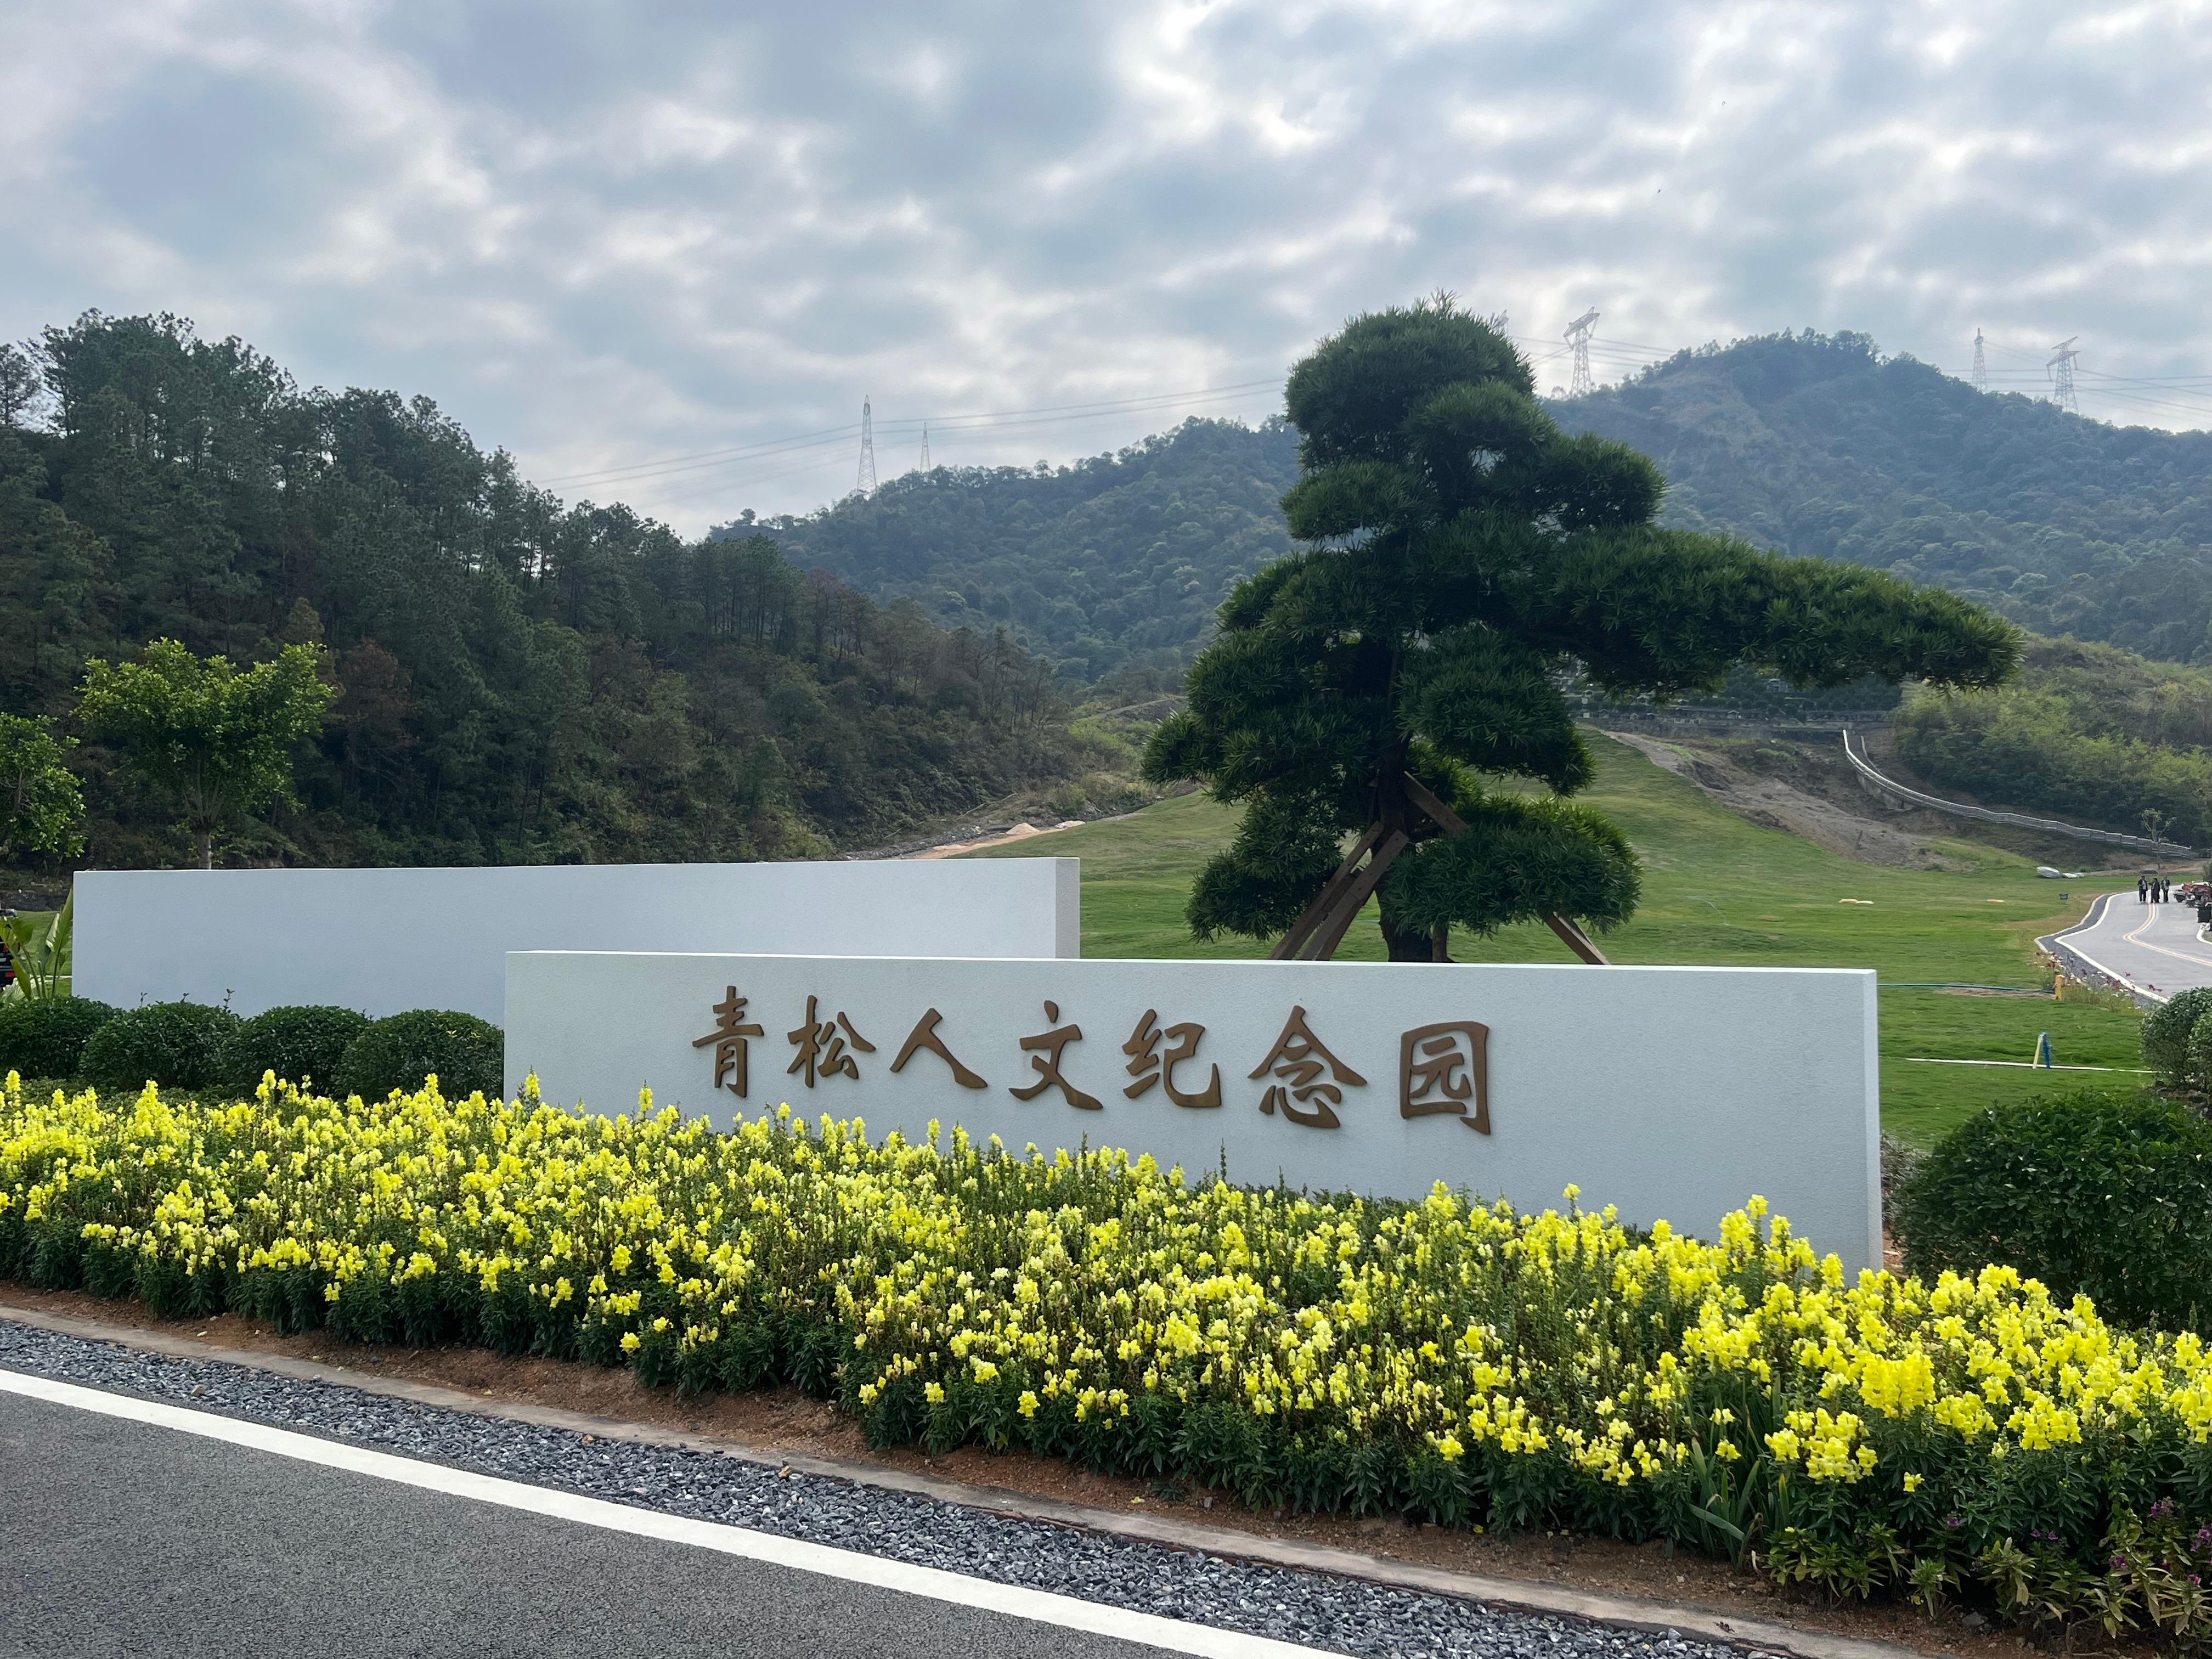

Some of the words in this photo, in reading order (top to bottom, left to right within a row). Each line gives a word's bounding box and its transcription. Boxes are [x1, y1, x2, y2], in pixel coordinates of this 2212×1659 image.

[693, 986, 1490, 1135] 青松人文纪念园
